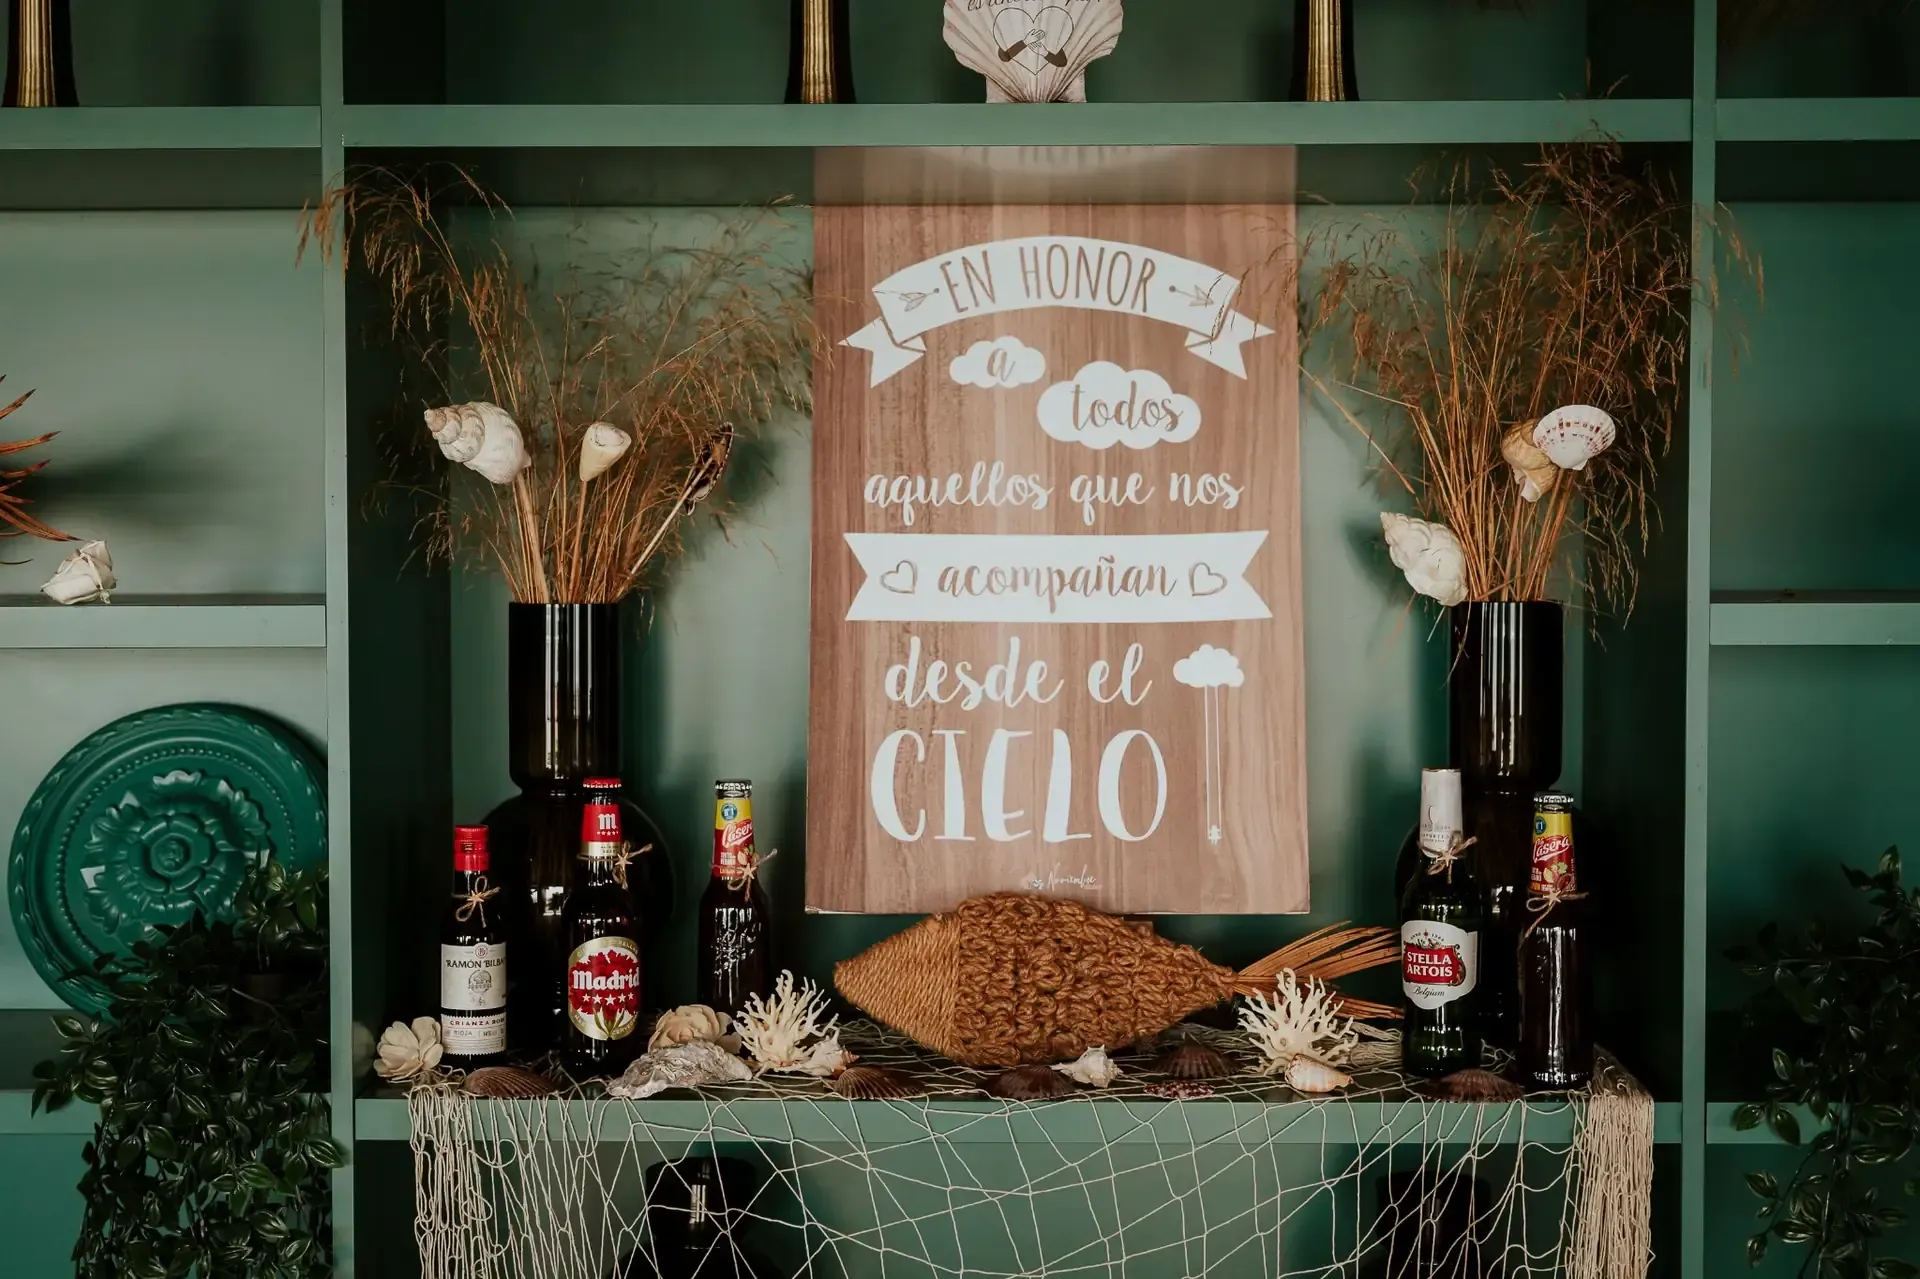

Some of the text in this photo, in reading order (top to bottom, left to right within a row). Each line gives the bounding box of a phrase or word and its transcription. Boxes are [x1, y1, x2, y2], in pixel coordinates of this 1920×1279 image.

[940, 243, 1156, 314] EN HONOR
[986, 346, 1014, 382] a
[1070, 380, 1183, 432] todos
[863, 460, 1246, 527] aquellos que nos
[937, 554, 1179, 615] acompañan
[884, 635, 1153, 711] desde el
[871, 728, 1168, 844] CIELO
[446, 958, 483, 969] RAMÓN
[572, 967, 640, 990] Madrid
[1407, 951, 1452, 964] STELLA
[1407, 964, 1453, 976] ARTOIS
[1414, 986, 1445, 999] Belgium
